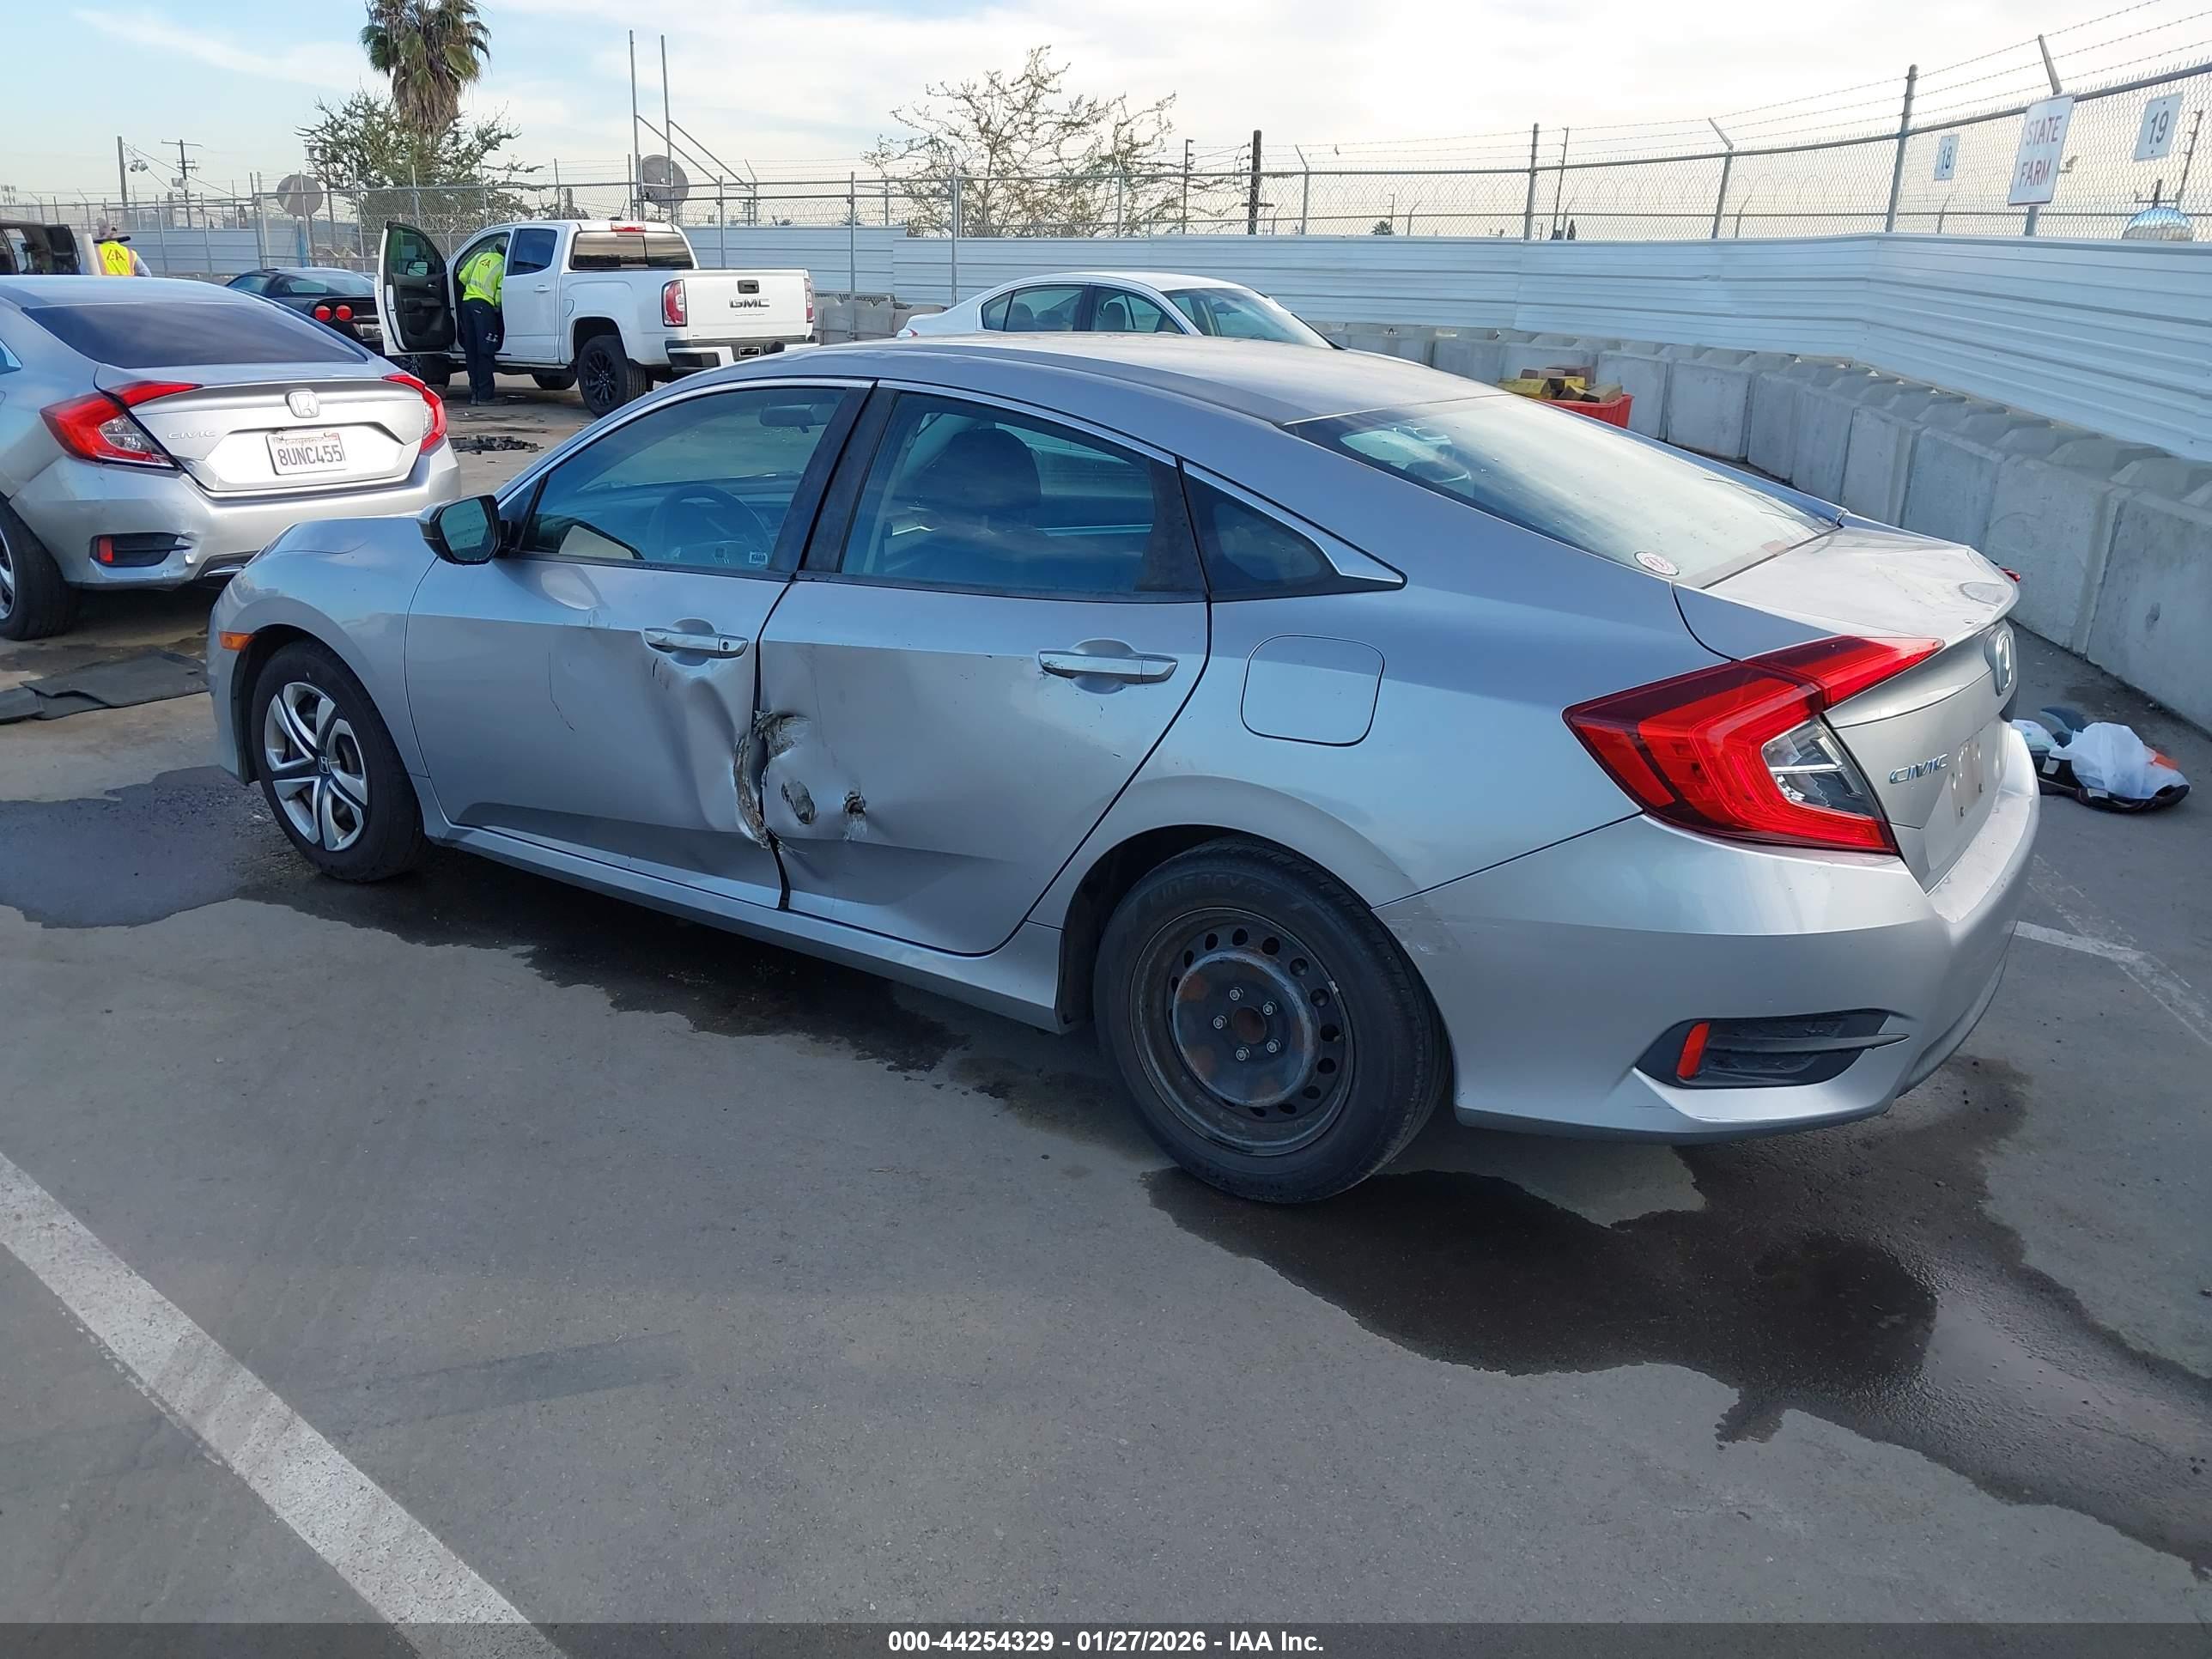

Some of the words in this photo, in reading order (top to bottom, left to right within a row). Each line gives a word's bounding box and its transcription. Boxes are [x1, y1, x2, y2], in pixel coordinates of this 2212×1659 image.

[2025, 115, 2063, 146] STATE
[2148, 110, 2169, 145] 19
[1942, 145, 1953, 170] 18
[2019, 159, 2051, 187] FARM
[728, 298, 770, 308] GMC
[167, 429, 216, 440] CIVIC
[276, 443, 343, 466] 8UNC455
[1889, 753, 1948, 784] CIVIC
